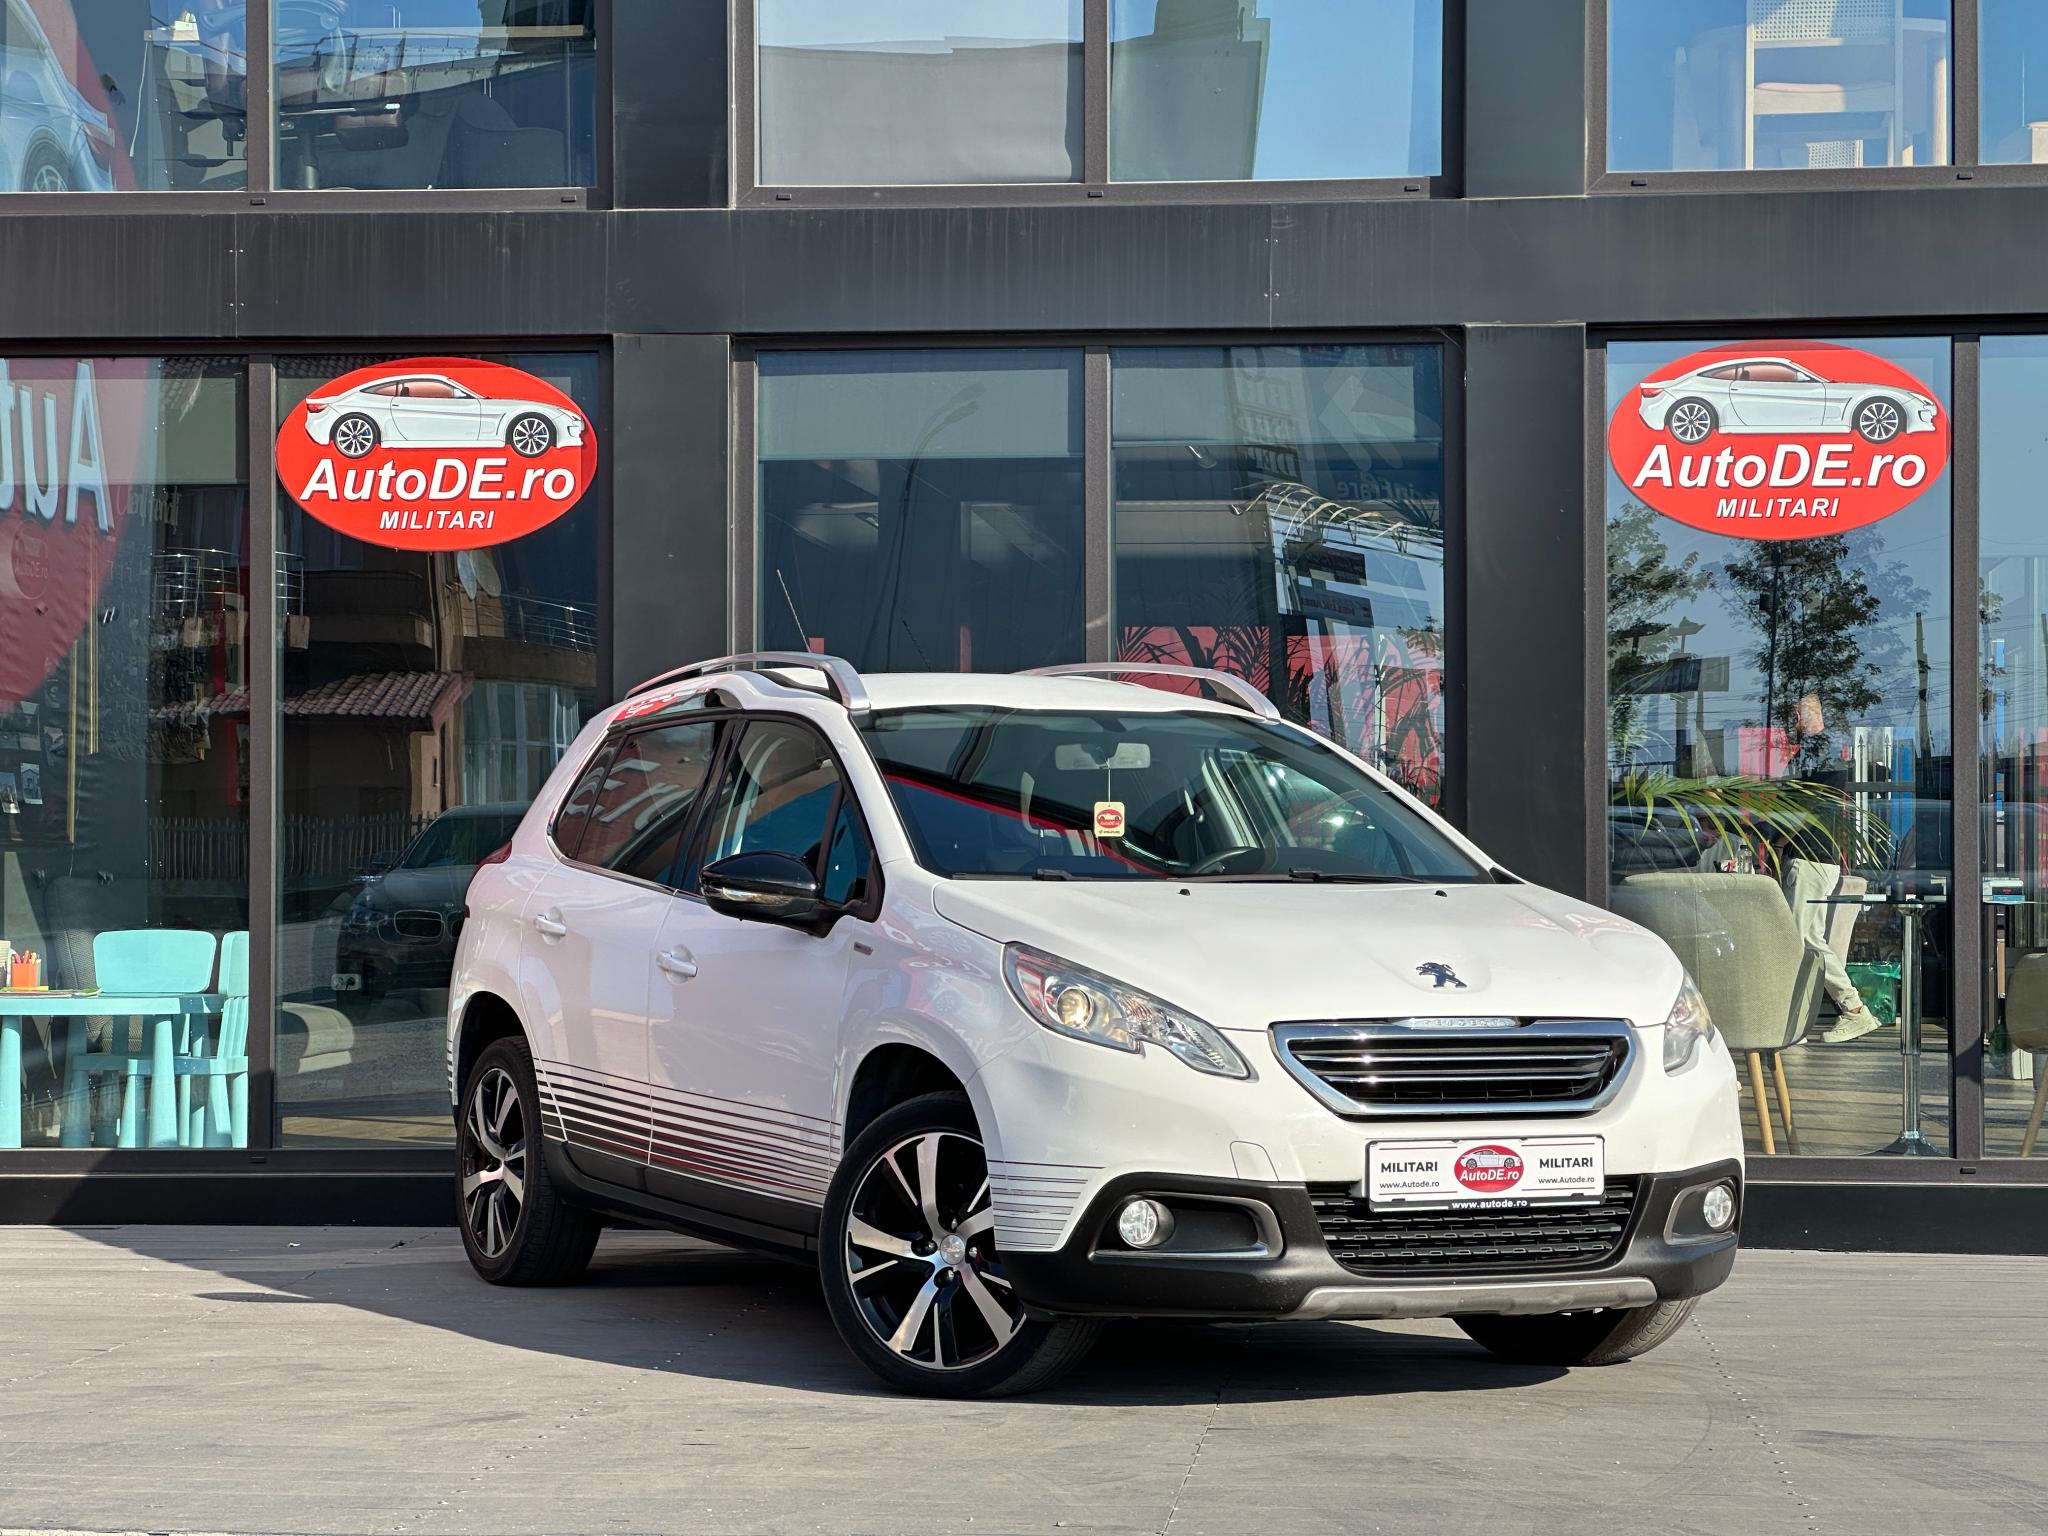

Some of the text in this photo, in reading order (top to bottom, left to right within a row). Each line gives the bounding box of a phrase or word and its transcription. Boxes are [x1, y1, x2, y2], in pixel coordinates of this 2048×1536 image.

[1633, 443, 1926, 488] AutoDE.ro
[300, 457, 575, 502] AutoDE.ro
[1715, 497, 1840, 518] MILITARI
[379, 510, 496, 531] MILITARI
[1380, 1161, 1438, 1174] MILITARI
[1539, 1157, 1593, 1169] MILITARI
[1460, 1168, 1520, 1182] AutoDE.ro
[1538, 1175, 1595, 1185] www.Autode.ro
[1379, 1180, 1440, 1189] www.Autode.ro
[1452, 1199, 1528, 1209] www.autode.ro
